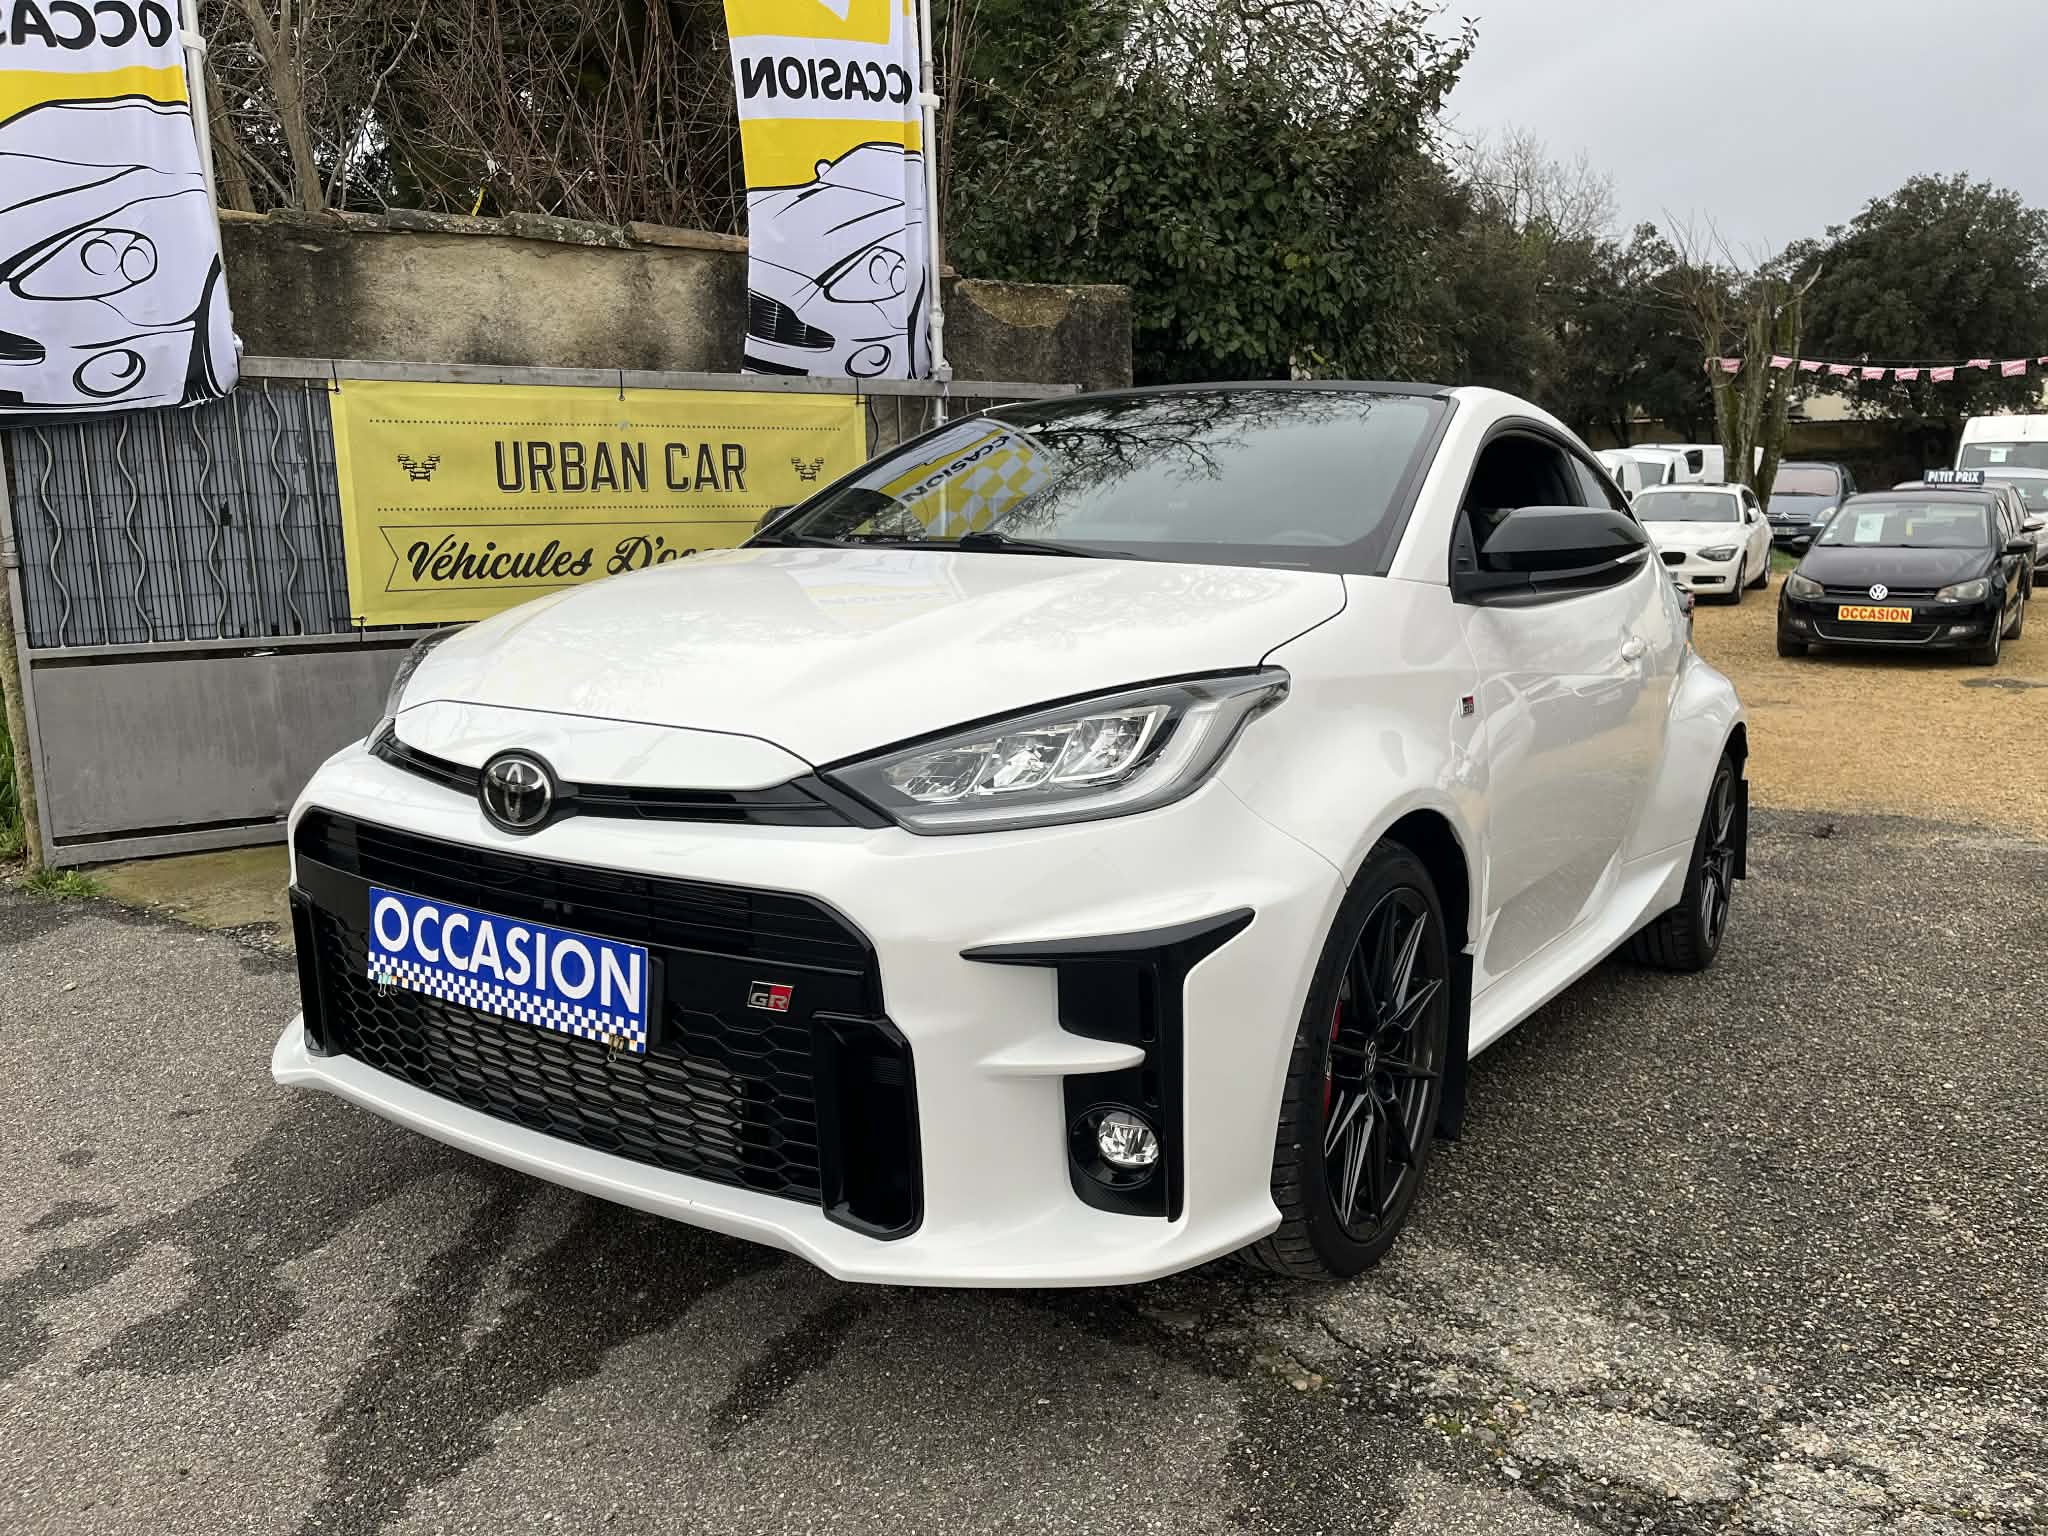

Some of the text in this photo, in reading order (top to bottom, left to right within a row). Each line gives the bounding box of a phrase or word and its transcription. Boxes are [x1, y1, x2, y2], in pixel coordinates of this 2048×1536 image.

[494, 440, 747, 493] URBAN CAR
[1955, 471, 1979, 483] PRIX
[407, 533, 594, 583] Véhicules
[1840, 607, 1910, 621] OCCASION
[373, 896, 641, 1014] OCCASION
[750, 992, 789, 1009] GR
